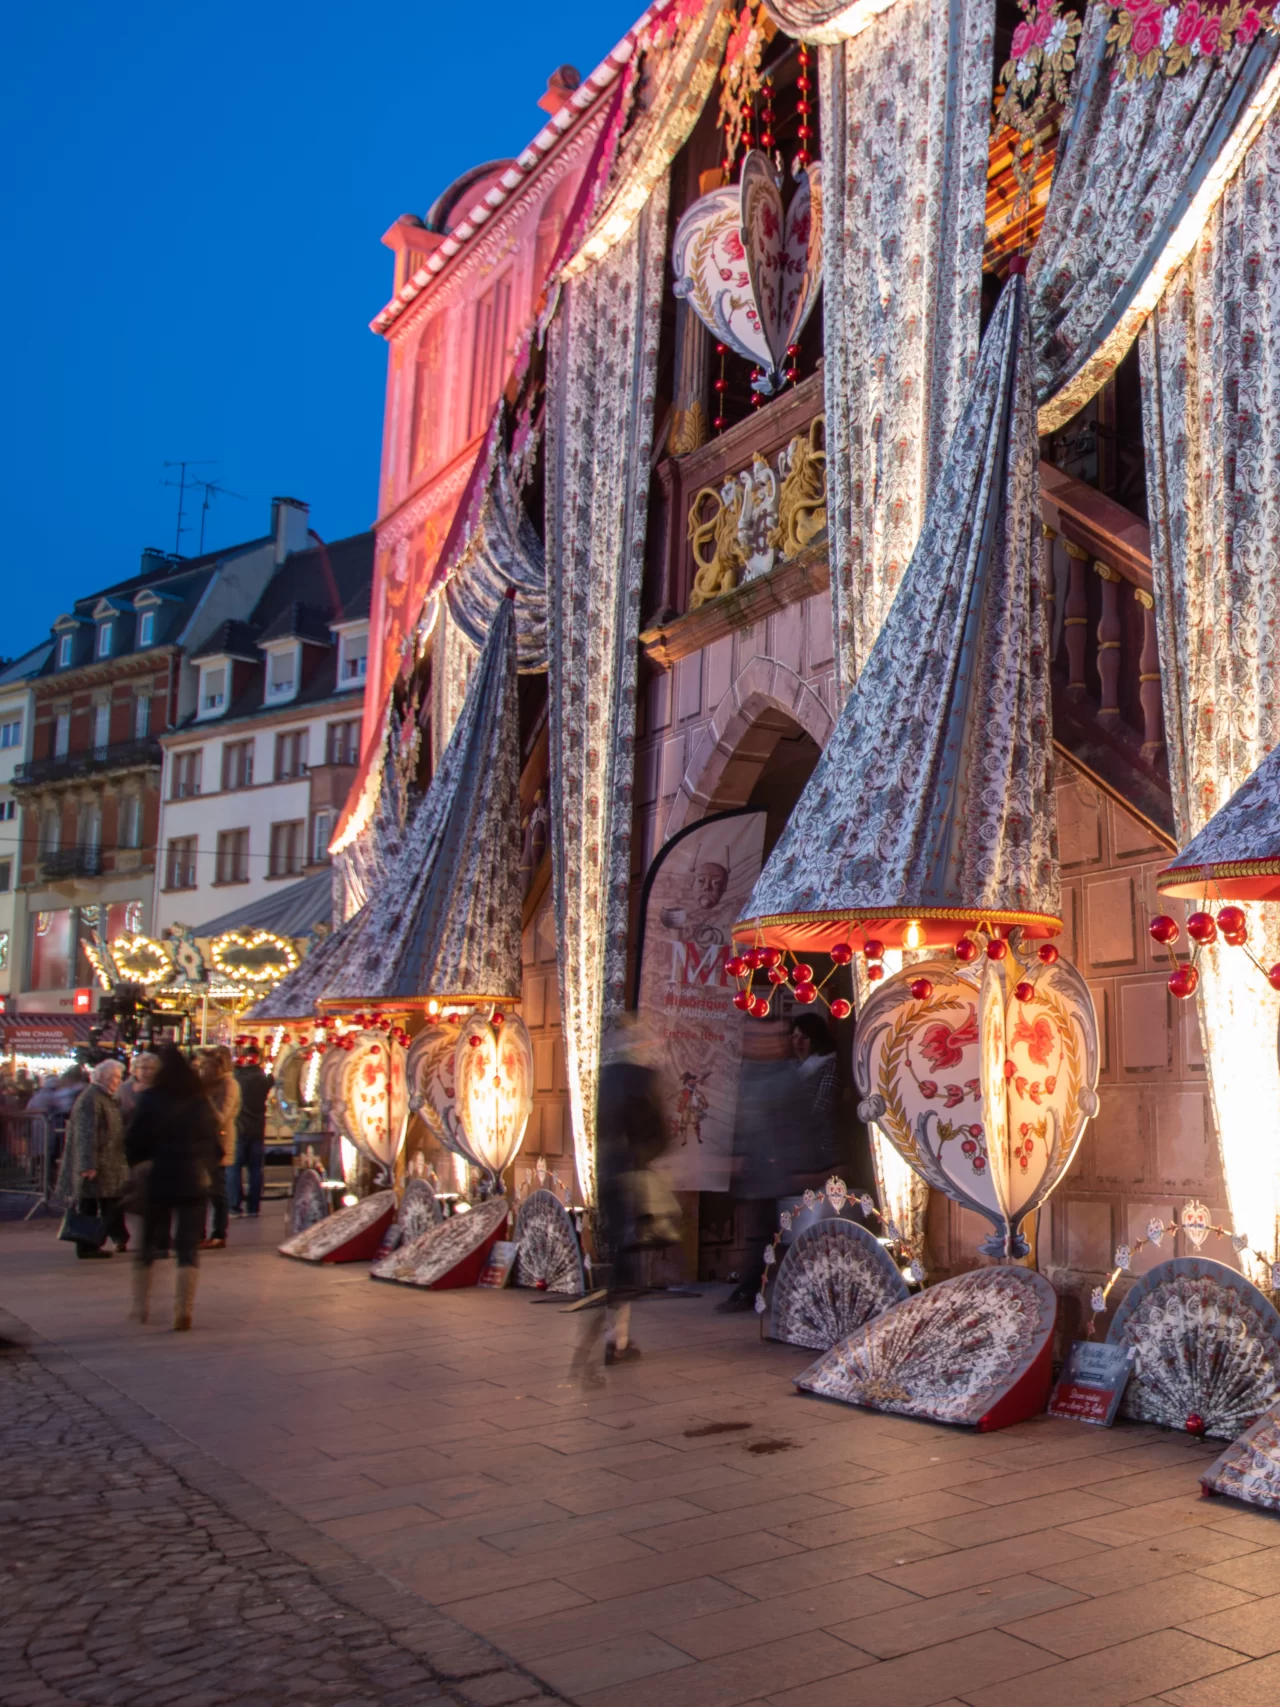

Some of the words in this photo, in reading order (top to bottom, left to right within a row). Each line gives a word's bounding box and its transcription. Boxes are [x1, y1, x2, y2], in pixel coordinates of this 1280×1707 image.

[664, 985, 699, 997] Musée
[664, 995, 729, 1011] Historique
[663, 1006, 677, 1016] de
[679, 1007, 728, 1019] Mulhouse
[663, 1027, 697, 1040] Entrée
[700, 1031, 726, 1042] libre
